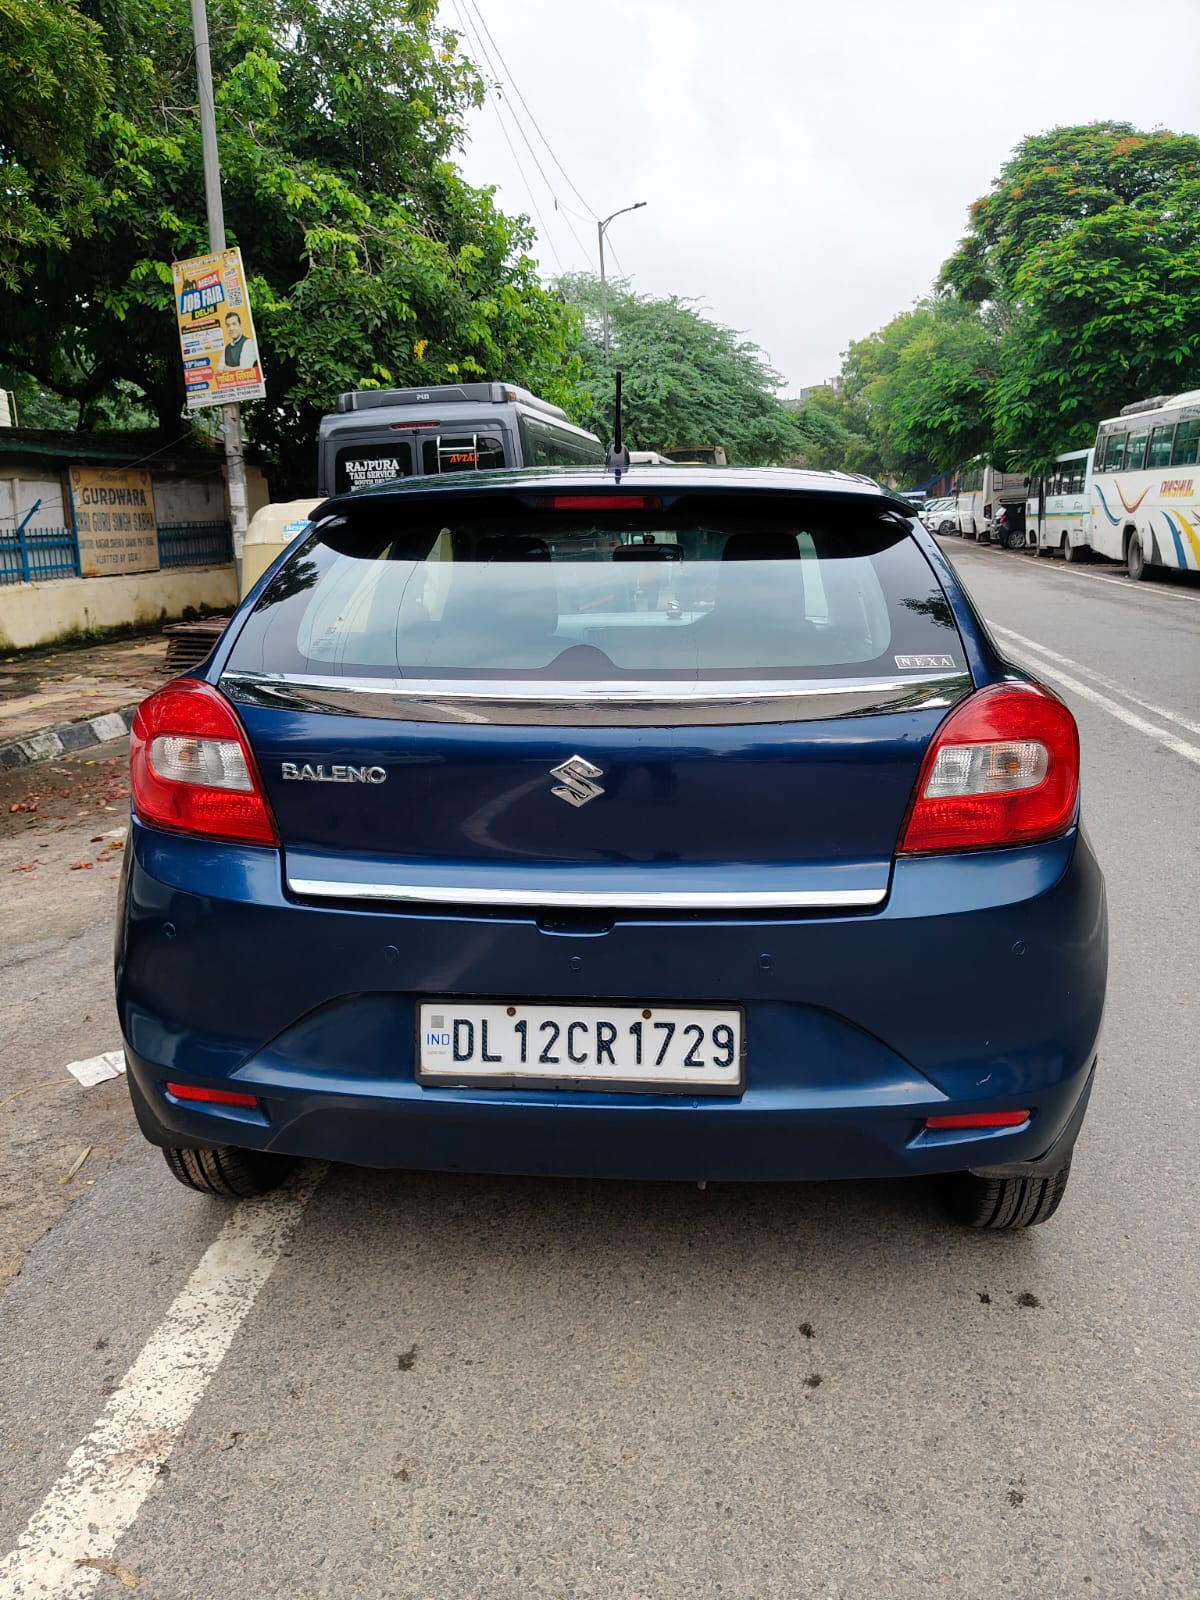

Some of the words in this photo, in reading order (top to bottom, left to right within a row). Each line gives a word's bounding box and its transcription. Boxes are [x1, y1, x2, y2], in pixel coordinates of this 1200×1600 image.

[182, 291, 201, 314] JOB
[202, 285, 223, 308] FAIR
[195, 306, 215, 319] DELHI
[345, 459, 400, 472] RAJPURA
[349, 472, 366, 480] TAXI
[367, 470, 397, 479] SERVICE
[82, 488, 147, 506] GURDWARA
[901, 657, 951, 666] NEXA
[281, 762, 387, 784] BALENO
[426, 1033, 450, 1046] IND
